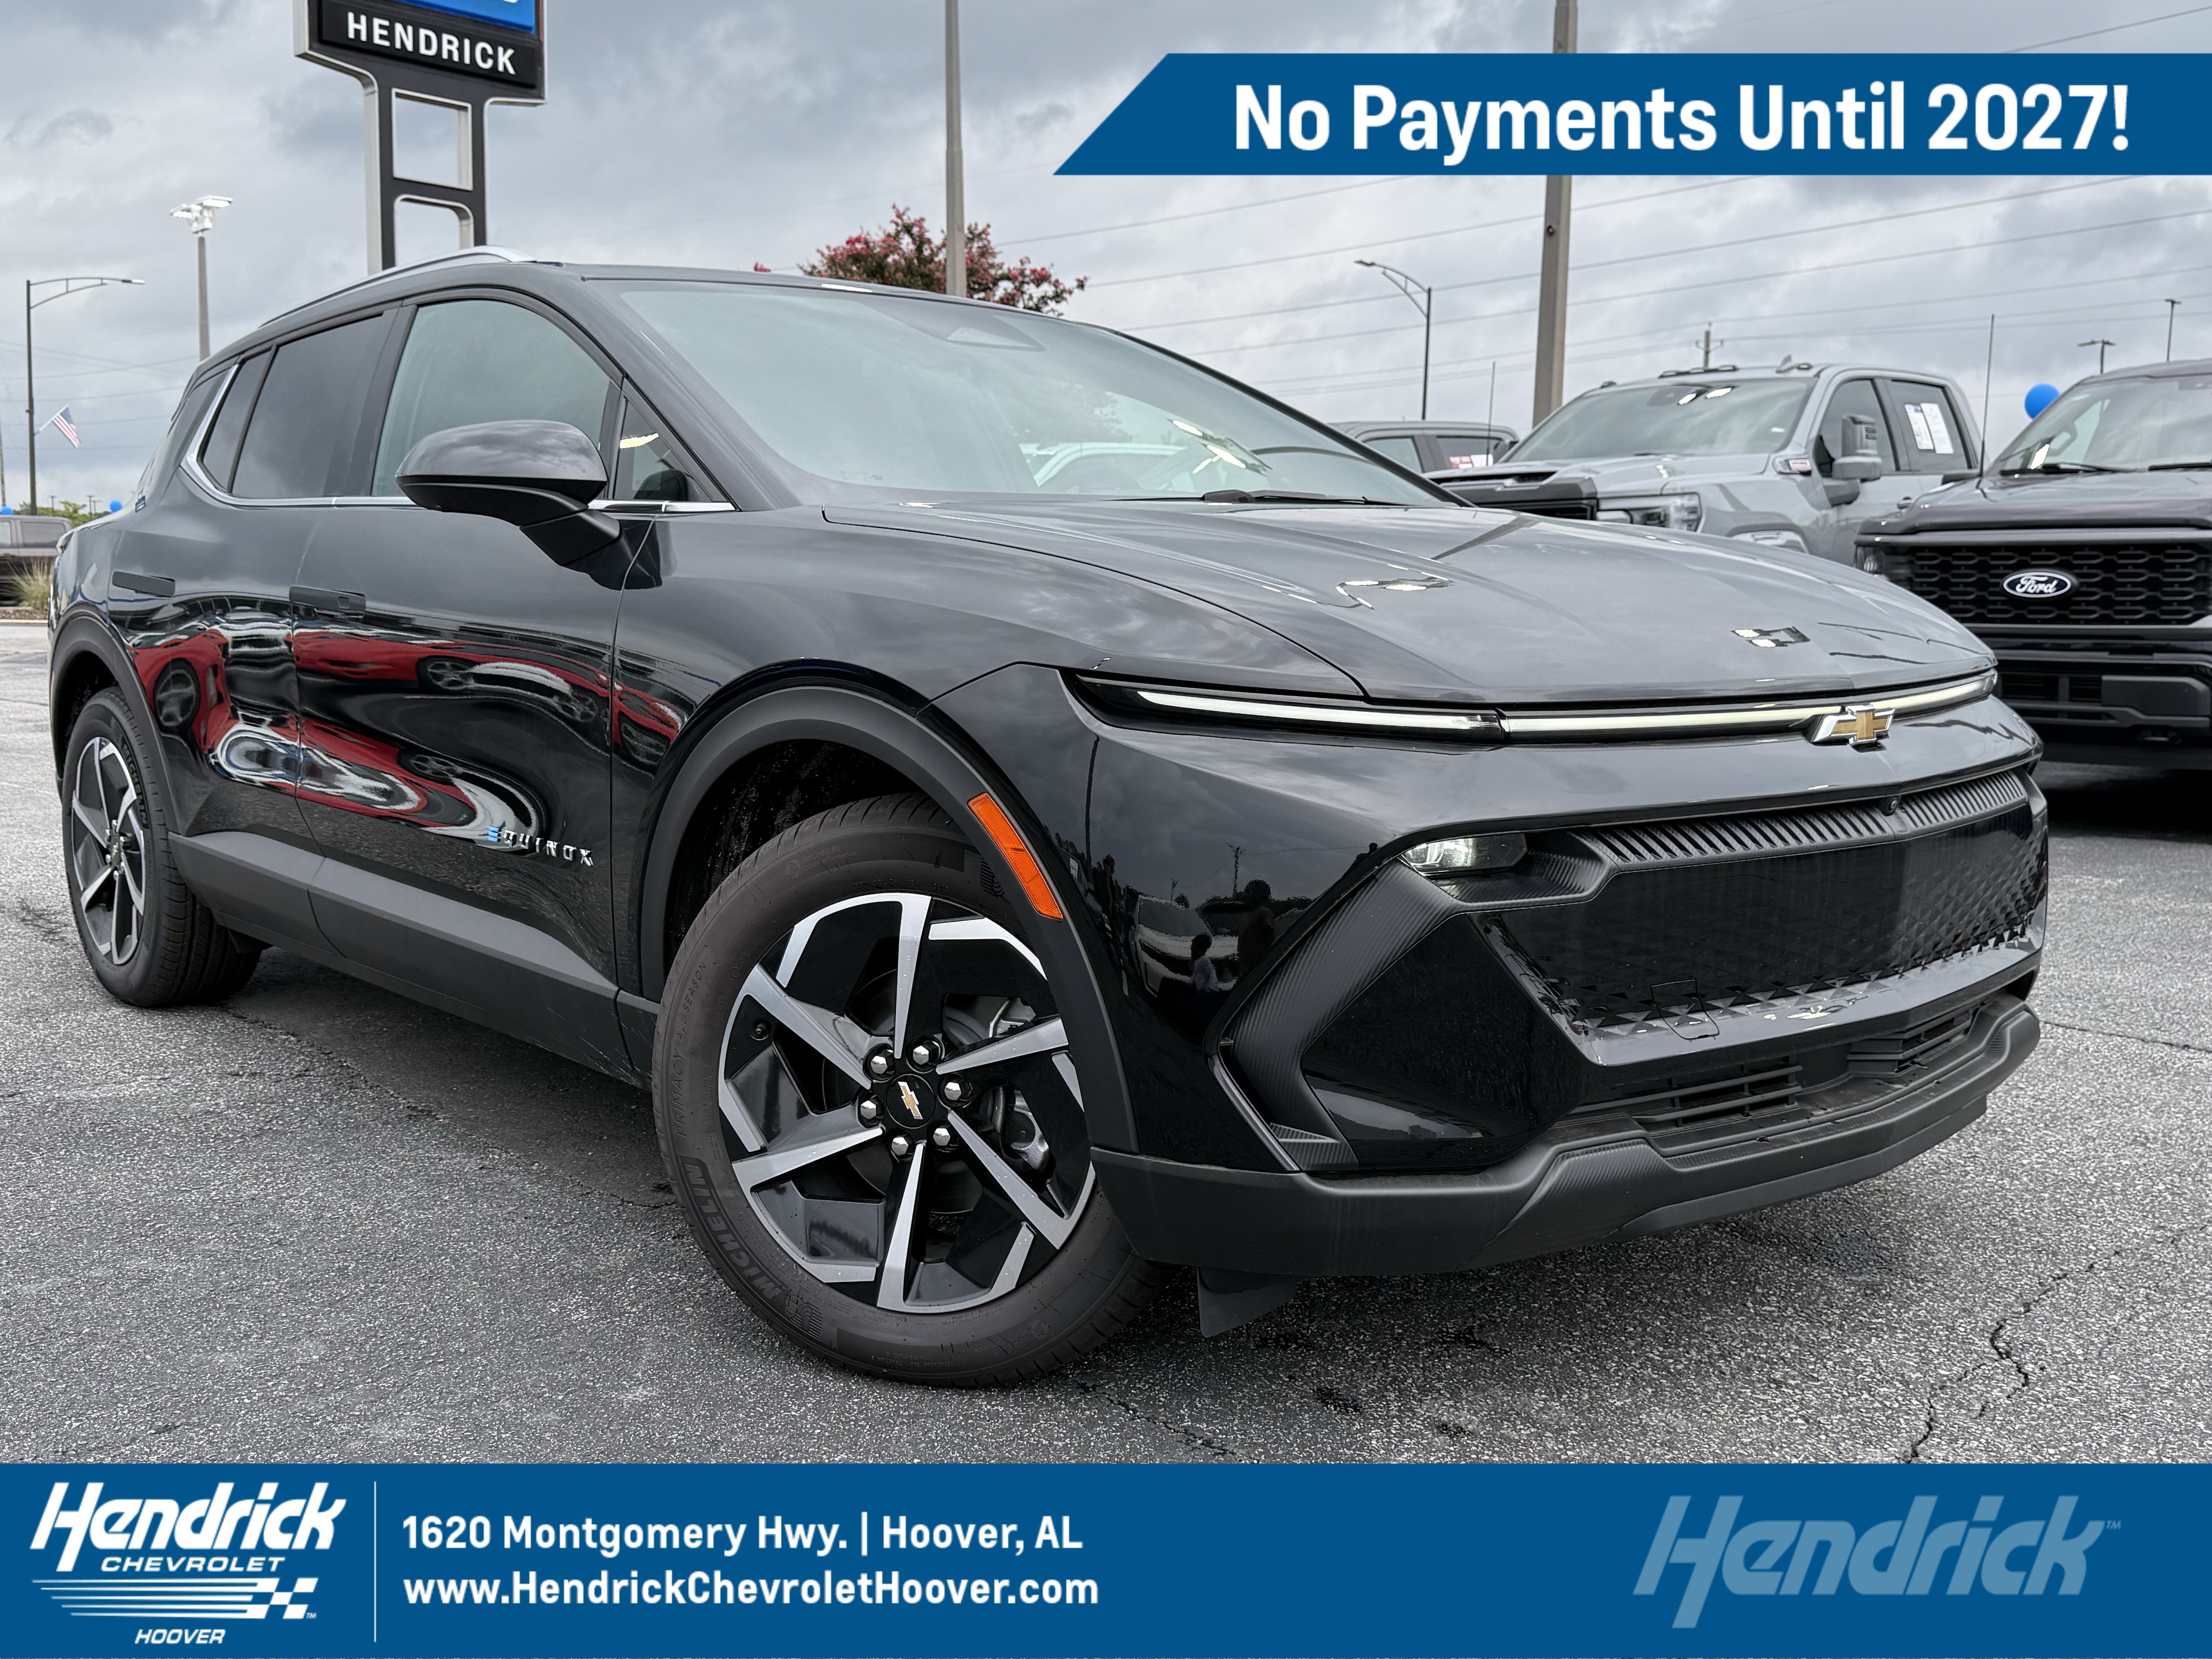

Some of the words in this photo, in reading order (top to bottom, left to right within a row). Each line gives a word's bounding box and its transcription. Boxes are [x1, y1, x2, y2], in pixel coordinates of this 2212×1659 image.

[348, 11, 516, 75] HENDRICK
[2015, 575, 2057, 594] Ford
[487, 825, 593, 866] EQUINOX
[683, 962, 708, 1013] SEASON
[676, 1018, 687, 1040] ALL
[671, 1053, 688, 1137] PRIMACY
[685, 1164, 782, 1300] MICHELIN
